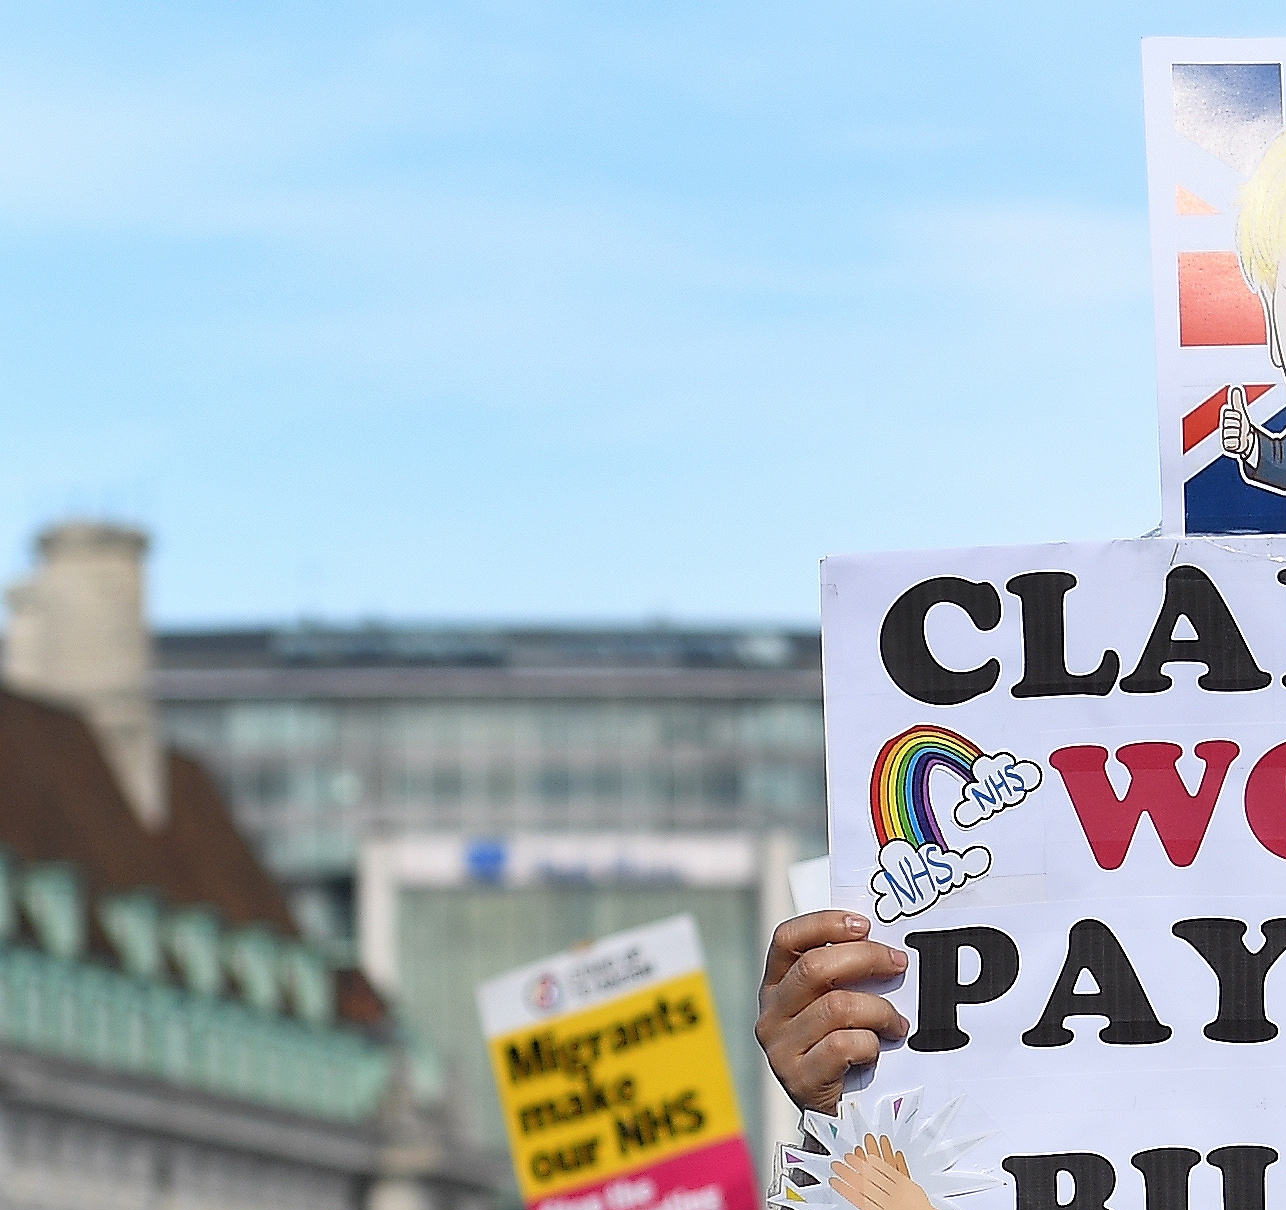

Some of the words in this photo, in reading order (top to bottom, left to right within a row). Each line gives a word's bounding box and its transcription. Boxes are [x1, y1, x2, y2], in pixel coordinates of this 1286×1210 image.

[971, 765, 1025, 811] NHS
[884, 847, 953, 907] NHS
[505, 997, 700, 1083] Migrants
[519, 1066, 637, 1135] make
[530, 1138, 600, 1184] our
[613, 1090, 707, 1156] NHS
